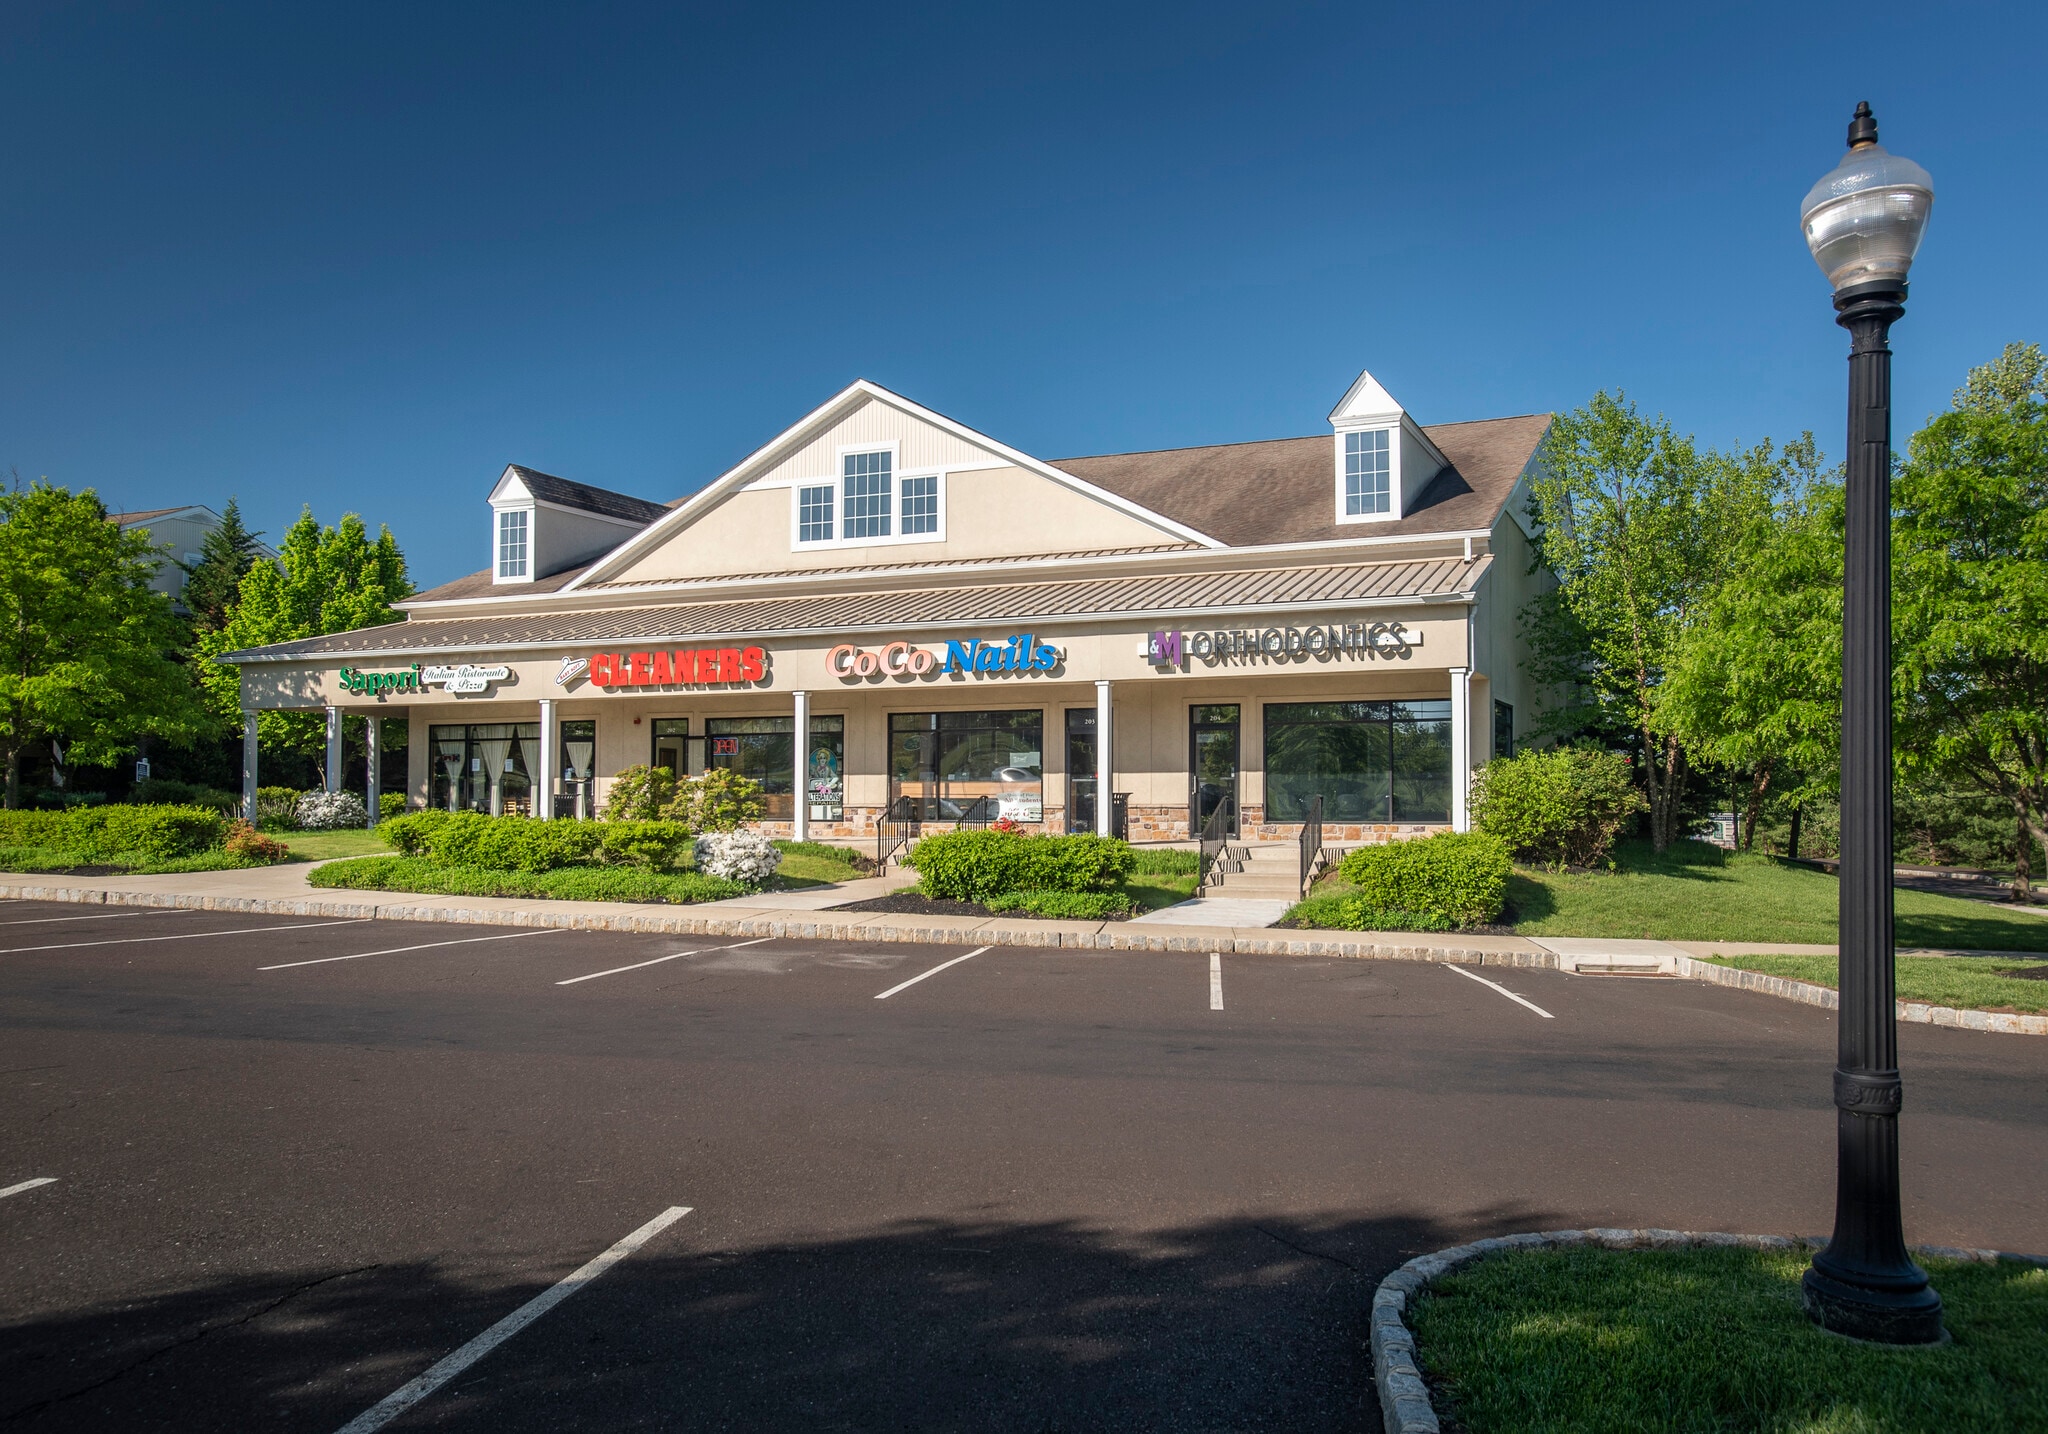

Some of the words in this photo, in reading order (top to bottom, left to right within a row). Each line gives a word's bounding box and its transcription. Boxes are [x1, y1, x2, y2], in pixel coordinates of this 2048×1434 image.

[825, 641, 933, 678] CoCo
[940, 633, 1058, 674] Nails
[1191, 622, 1409, 660] ORTHODONTICS
[339, 663, 419, 696] Sapori
[423, 667, 455, 680] Italian
[457, 666, 506, 679] Ristorante
[590, 646, 765, 686] CLEANERS
[446, 681, 454, 690] &
[457, 680, 483, 690] Pizza
